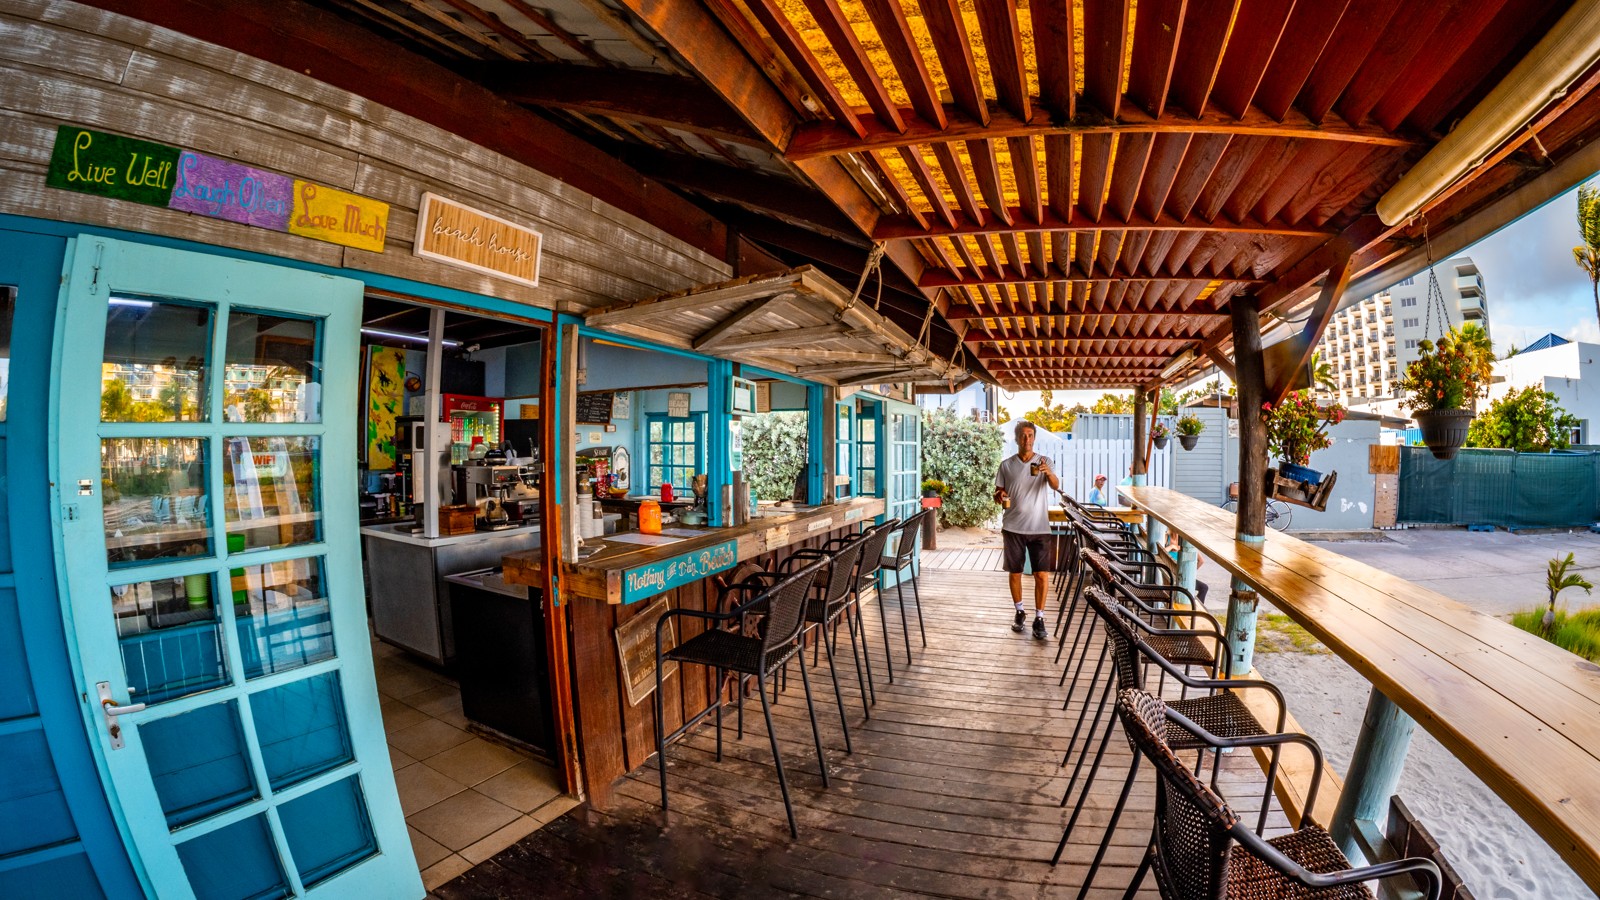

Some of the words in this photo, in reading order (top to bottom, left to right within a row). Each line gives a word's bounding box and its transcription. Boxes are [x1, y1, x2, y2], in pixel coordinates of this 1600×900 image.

[67, 131, 116, 184] Live
[126, 153, 172, 189] Well
[175, 153, 234, 215] Laugh
[238, 177, 286, 216] Often
[296, 183, 338, 231] Love
[344, 204, 384, 242] Much
[432, 216, 485, 247] beach
[488, 233, 531, 263] house
[668, 408, 688, 417] TIME
[627, 568, 666, 593] Nothing
[678, 561, 698, 577] Day
[700, 544, 734, 575] Beach
[639, 642, 657, 662] Bette
